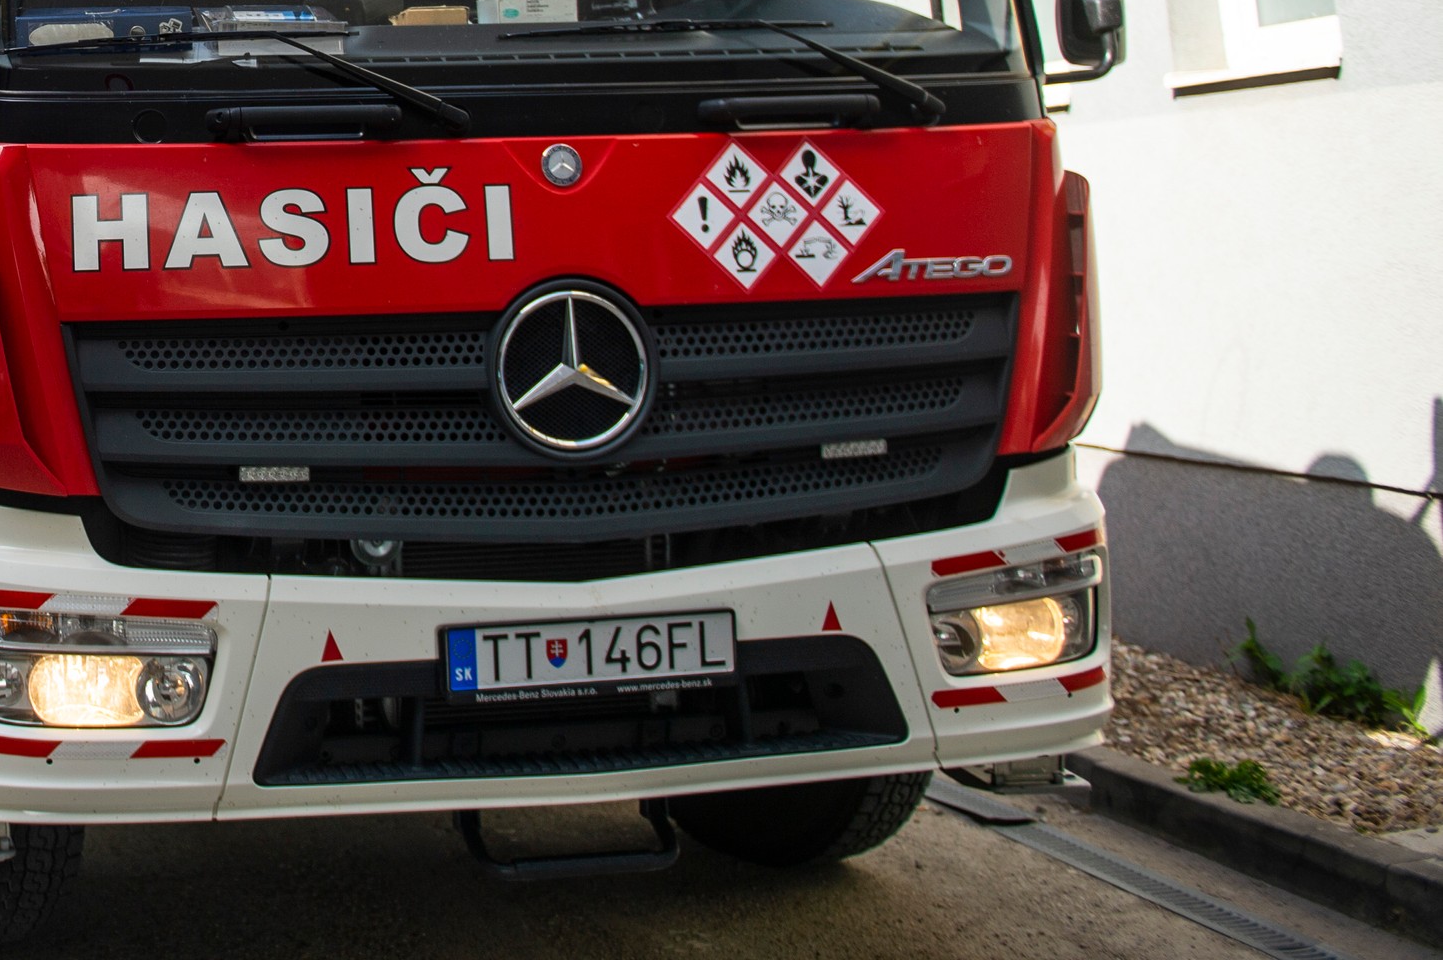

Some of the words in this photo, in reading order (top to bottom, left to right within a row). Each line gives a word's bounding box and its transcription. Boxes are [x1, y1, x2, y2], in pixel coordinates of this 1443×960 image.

[70, 167, 517, 273] HASIČI
[851, 248, 1013, 284] ATEGO
[482, 631, 541, 682] TT
[578, 621, 727, 676] 146FL
[455, 667, 473, 682] SK
[616, 678, 713, 694] www.mercedes-benz.sk
[476, 690, 540, 703] Mercedes-Benz
[541, 687, 576, 699] Slovakia
[577, 688, 598, 697] s.r.o.
